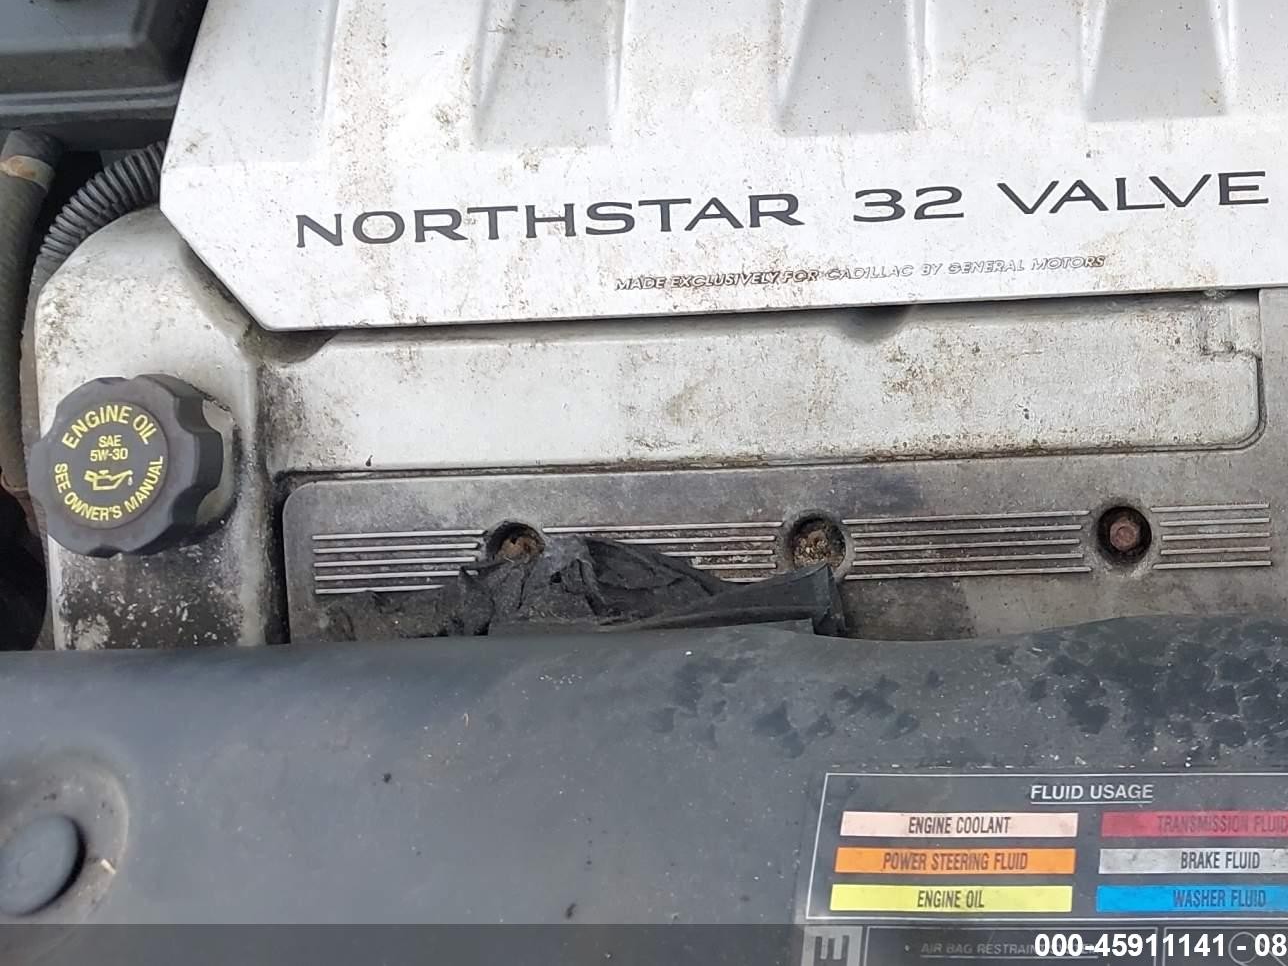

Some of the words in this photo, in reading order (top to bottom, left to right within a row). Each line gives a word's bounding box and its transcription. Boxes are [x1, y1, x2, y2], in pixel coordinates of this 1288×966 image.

[296, 193, 805, 249] NORTHSTAR
[853, 186, 966, 223] 32
[996, 171, 1270, 215] VALVE
[615, 276, 666, 290] MADE
[670, 271, 780, 288] EXCLUSIVELY
[782, 270, 819, 283] FOR
[824, 264, 914, 280] CADILLAC
[920, 263, 943, 276] BY
[949, 258, 1025, 274] GENERAL
[1031, 255, 1106, 270] MOTORS
[62, 405, 133, 449] ENGINE
[132, 414, 157, 445] OIL
[98, 434, 122, 447] SAE
[89, 448, 129, 462] 5W-30
[54, 463, 72, 494] SEE
[64, 491, 123, 521] OWNER'S
[123, 455, 164, 513] MANUAL
[1030, 784, 1084, 800] FLUID
[1090, 784, 1154, 800] USAGE
[908, 817, 952, 834] ENGINE
[956, 816, 1011, 834] COOLANT
[1157, 815, 1249, 833] TRANSMISSION
[1253, 815, 1288, 832] FLUID
[883, 852, 927, 870] POWER
[931, 852, 989, 870] STEERING
[993, 852, 1029, 870] FLUID
[1181, 852, 1220, 869] BRAKE
[1225, 851, 1261, 869] FLUID
[917, 890, 961, 908] ENGINE
[966, 890, 985, 908] OIL
[1173, 890, 1226, 908] WASHER
[1230, 890, 1267, 907] FLUID
[921, 943, 943, 954] AIR
[977, 944, 1042, 955] RESTRAIN
